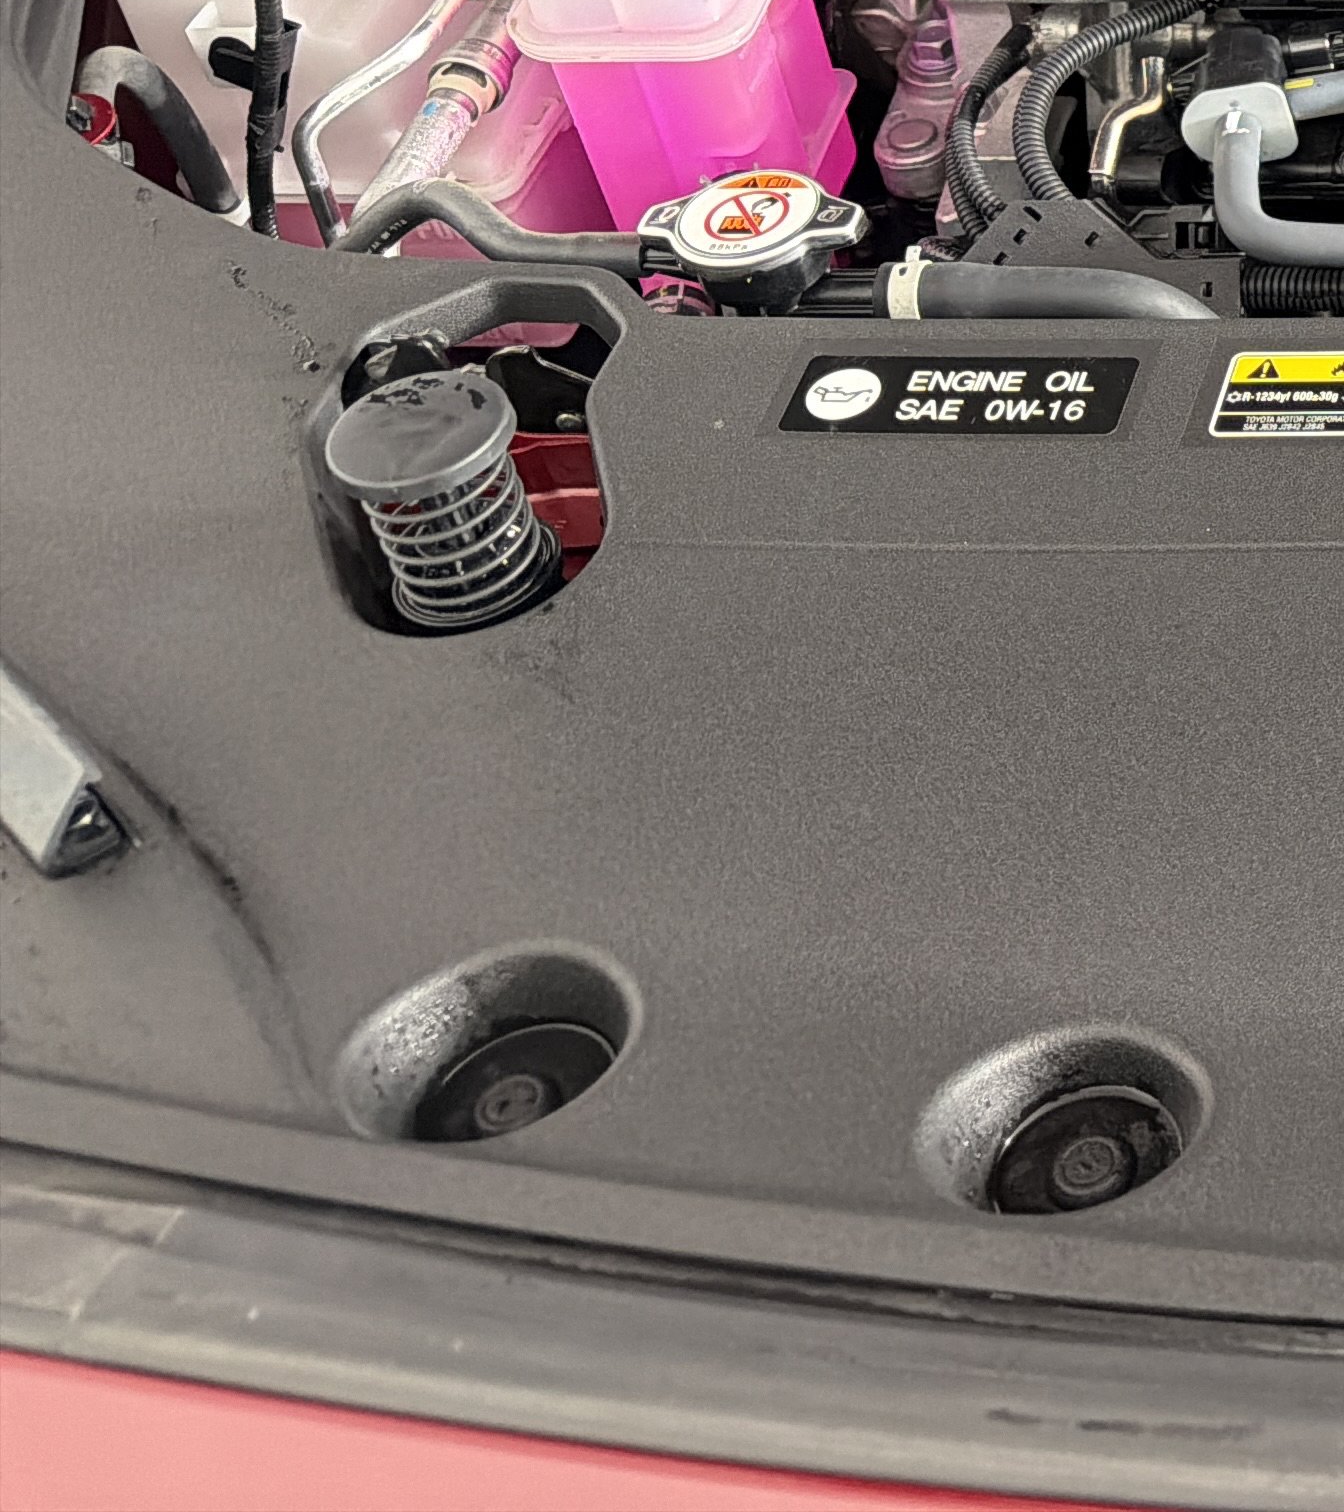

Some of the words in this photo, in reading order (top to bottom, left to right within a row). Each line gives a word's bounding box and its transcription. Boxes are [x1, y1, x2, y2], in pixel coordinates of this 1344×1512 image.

[907, 370, 1027, 392] ENGINE
[1045, 370, 1095, 393] OIL
[1242, 391, 1290, 403] R-1234yf
[1292, 391, 1339, 403] 600±30g
[895, 398, 964, 421] SAE
[984, 399, 1087, 421] 0W-16
[1245, 415, 1274, 424] TOYOTA
[1276, 415, 1305, 423] MOTOR
[1242, 423, 1258, 431] SAE
